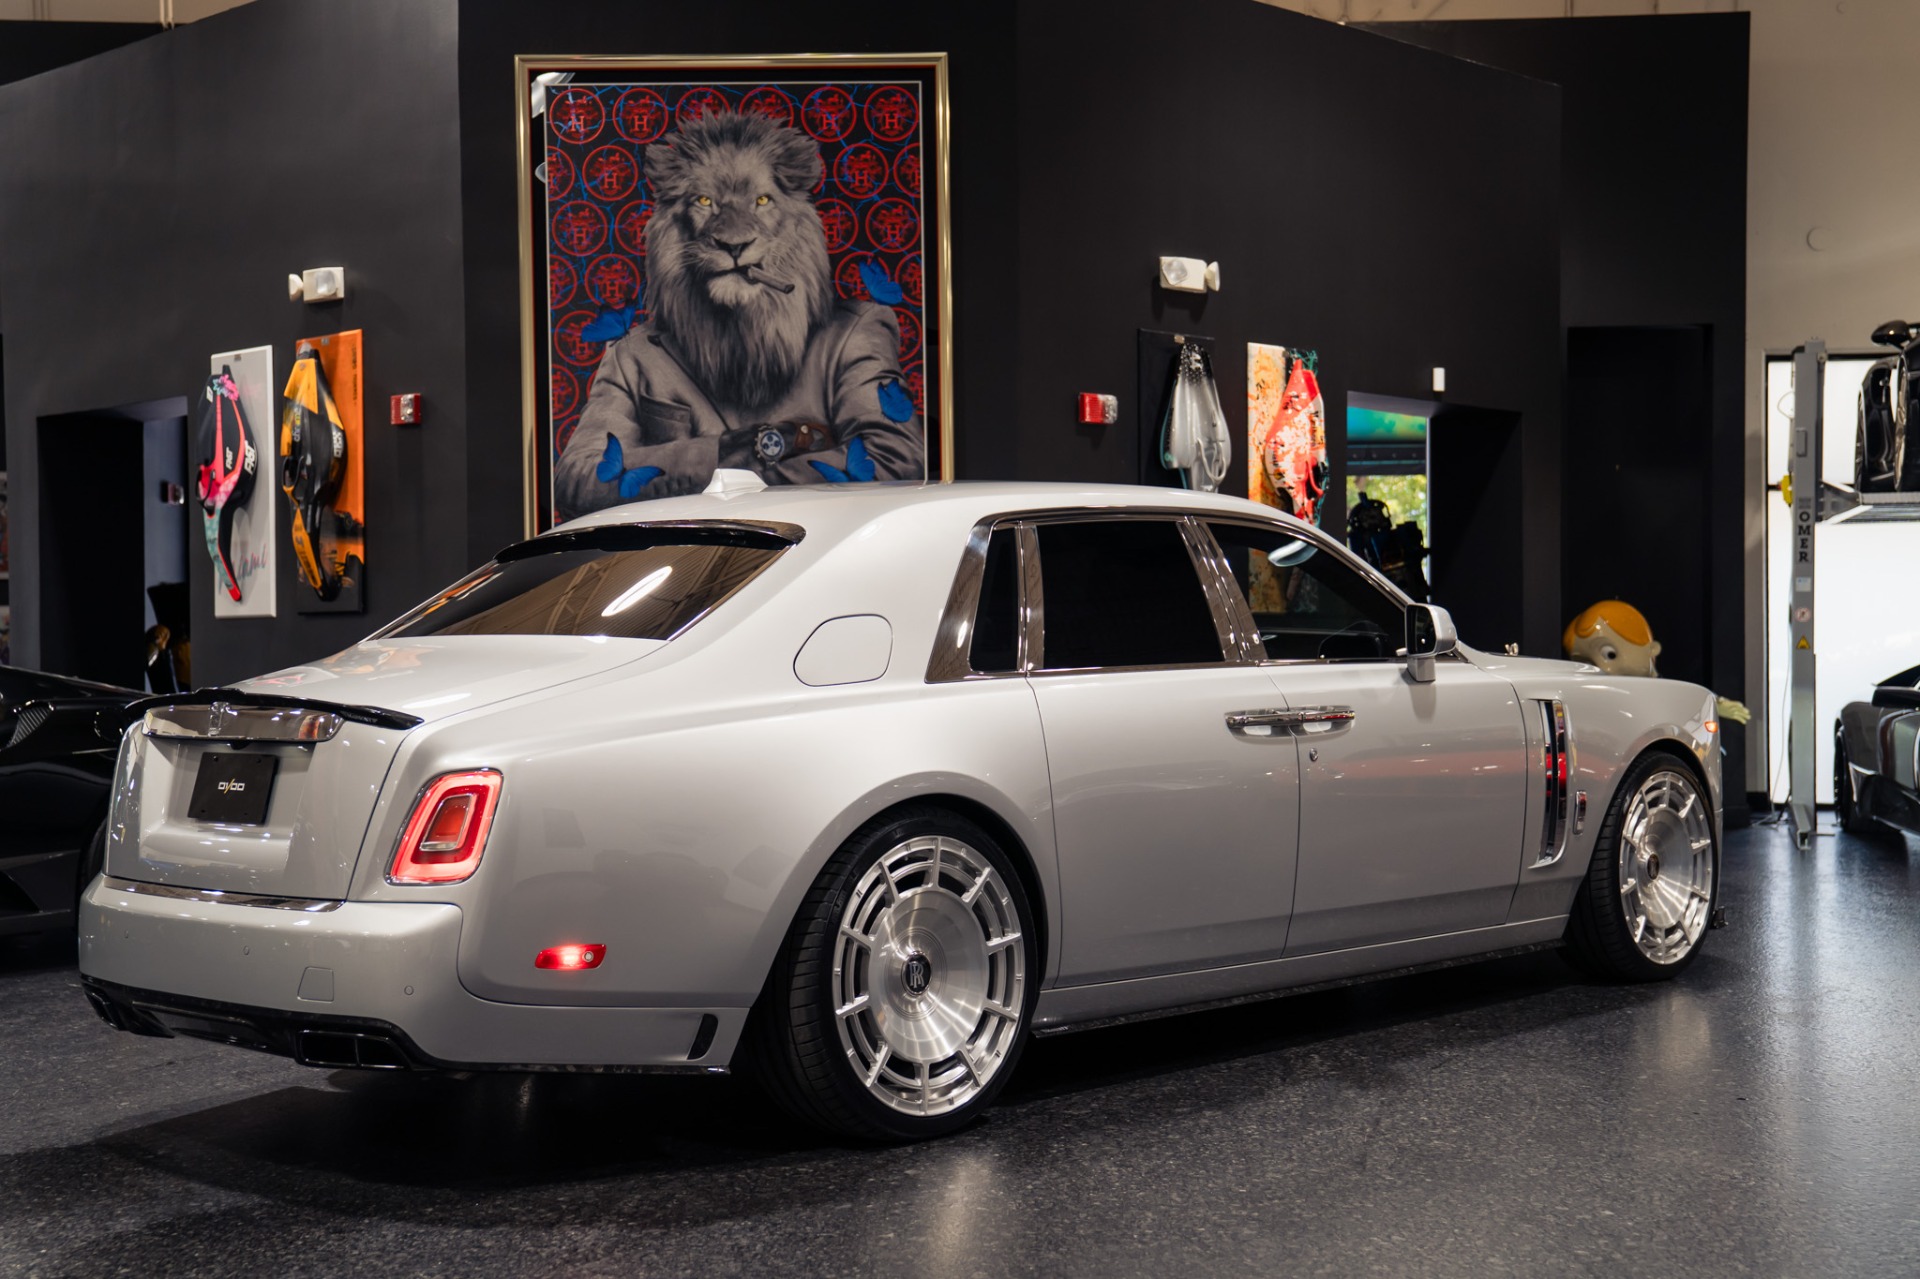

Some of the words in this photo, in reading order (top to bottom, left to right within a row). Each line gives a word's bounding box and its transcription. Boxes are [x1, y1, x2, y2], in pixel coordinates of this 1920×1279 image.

[634, 115, 649, 131] H
[884, 113, 899, 130] H
[604, 173, 618, 189] H
[1797, 511, 1811, 562] OMER
